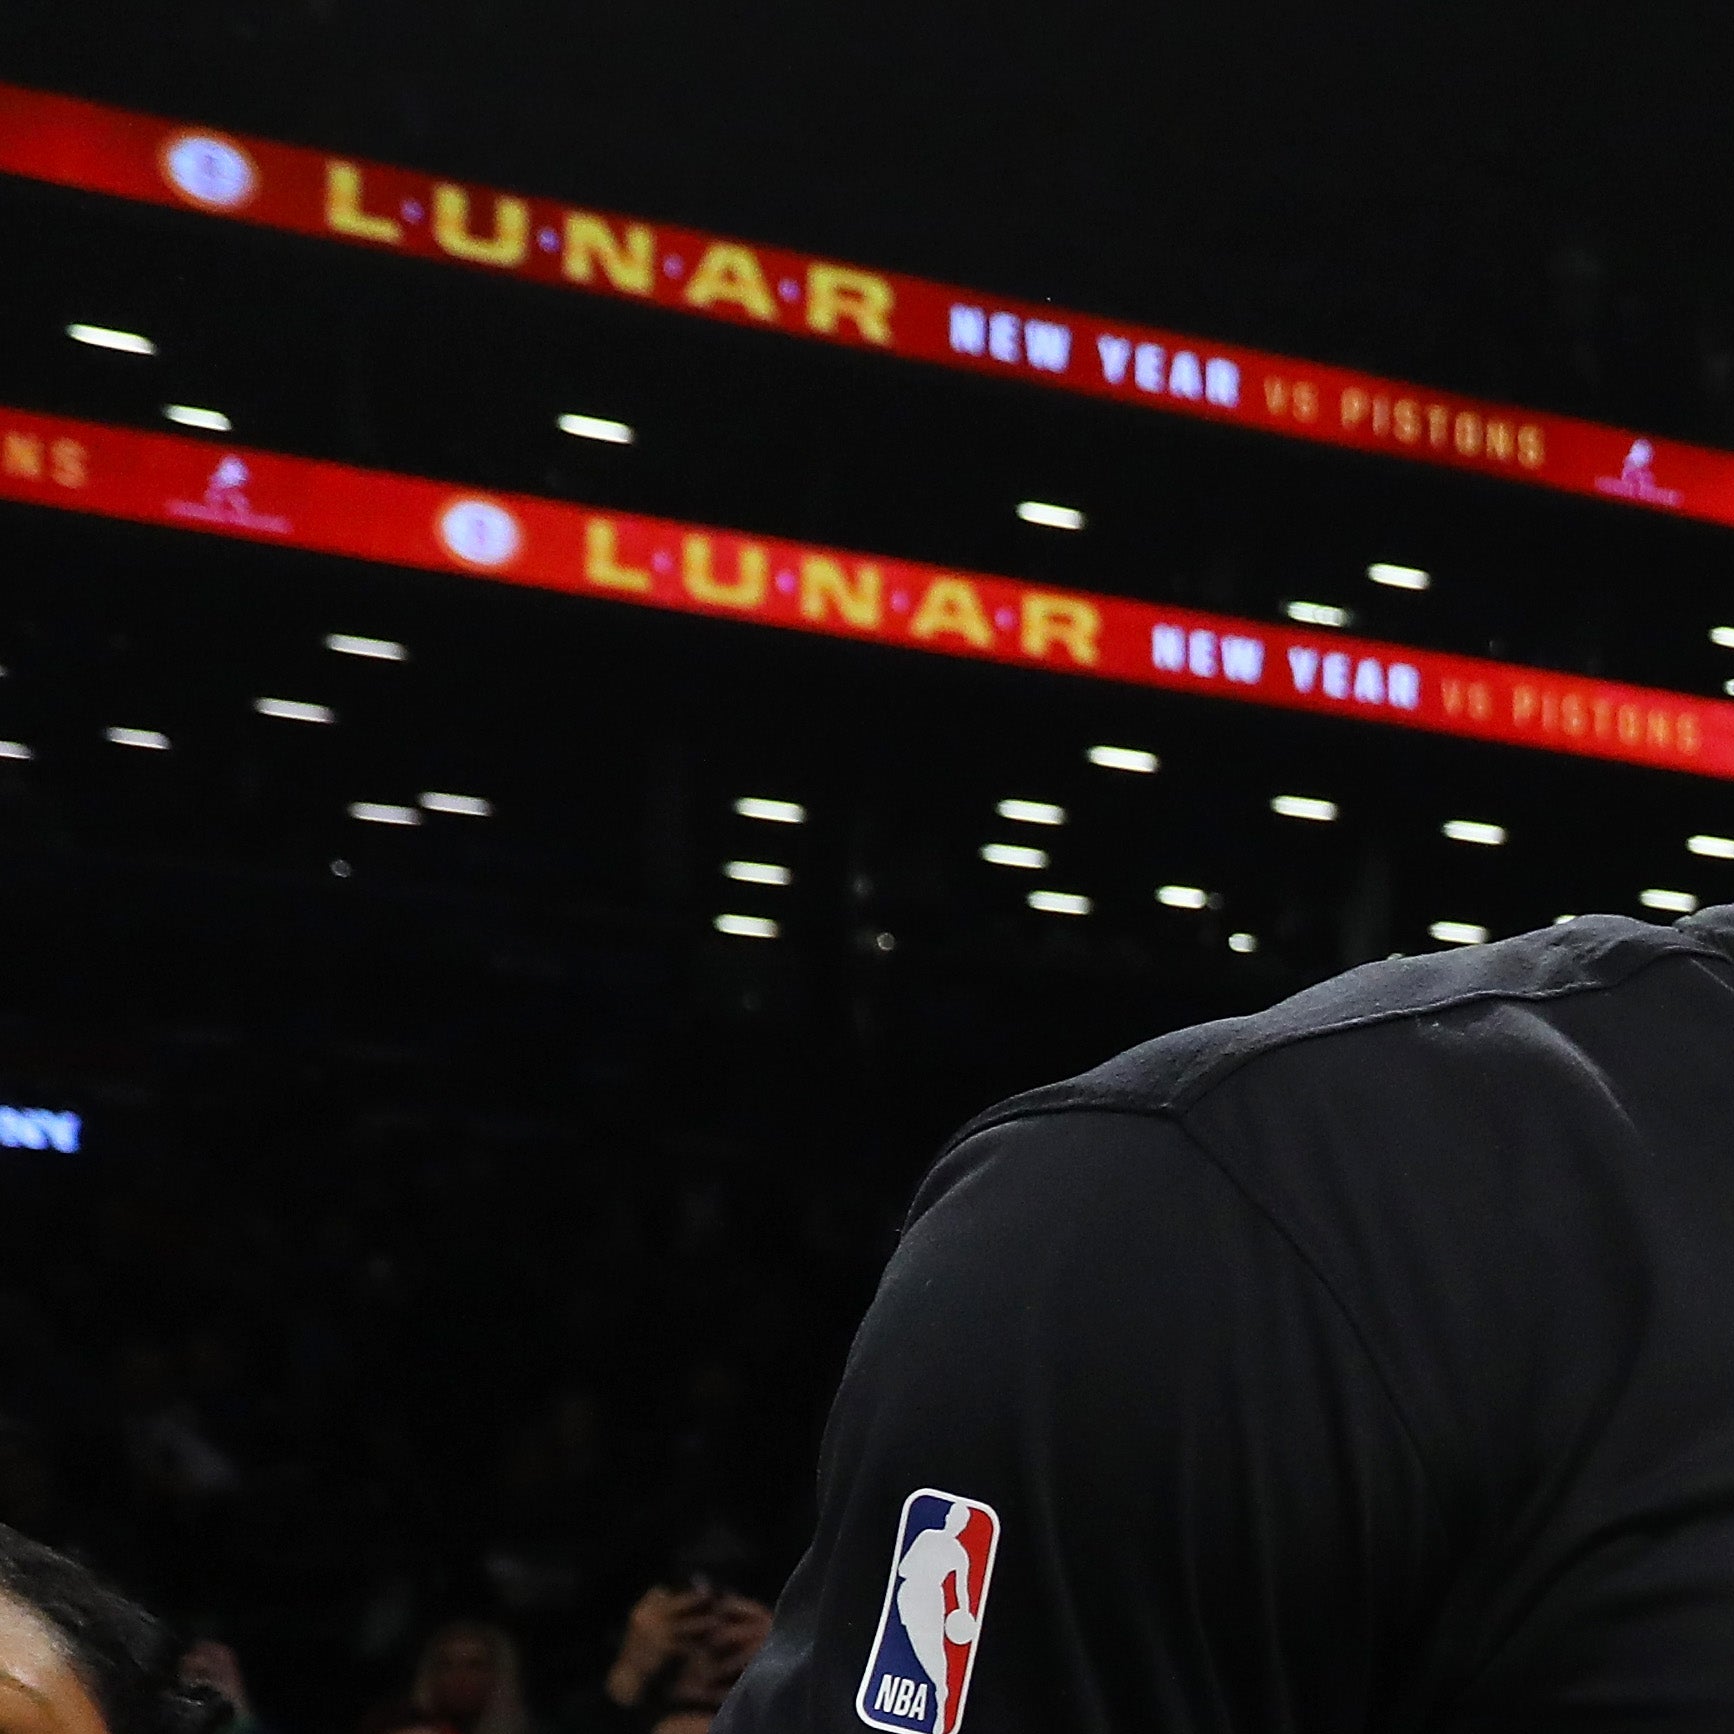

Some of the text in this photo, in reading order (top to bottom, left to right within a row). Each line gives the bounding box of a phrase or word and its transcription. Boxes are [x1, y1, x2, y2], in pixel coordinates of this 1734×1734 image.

[324, 160, 1545, 470] LUNAR NEW YEAR VS PISTONS
[585, 517, 1698, 755] LUNAR NEW YEAR VS PISTONS
[873, 1673, 929, 1722] NBA
